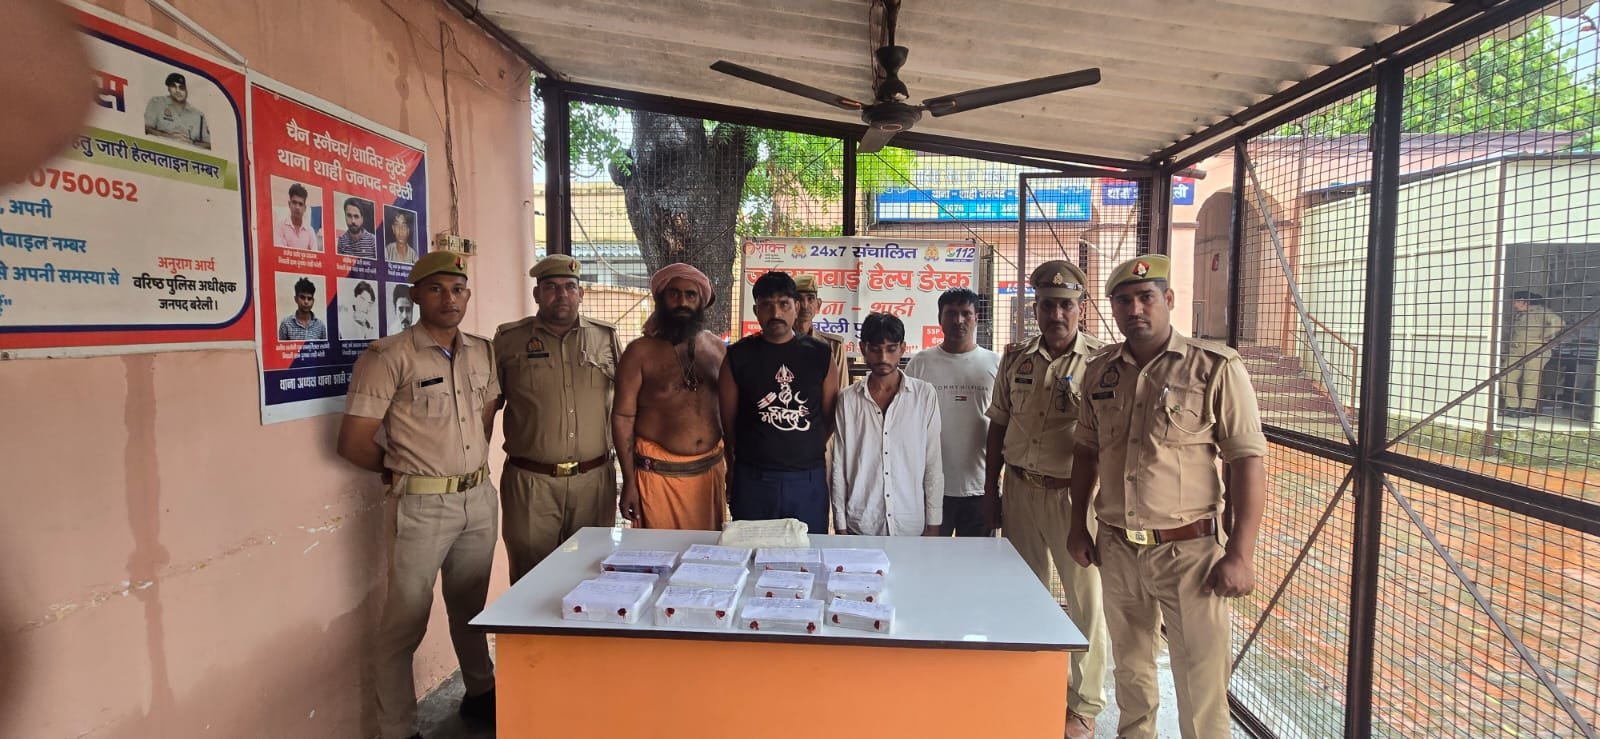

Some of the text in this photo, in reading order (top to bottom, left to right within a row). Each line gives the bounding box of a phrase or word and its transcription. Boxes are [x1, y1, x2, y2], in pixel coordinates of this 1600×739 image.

[96, 138, 128, 159] जारी
[131, 143, 189, 173] हेल्पलाइन
[191, 160, 220, 180] नम्बर
[286, 118, 310, 145] चैन
[385, 157, 408, 181] लुटेरे
[277, 148, 311, 173] थाना
[313, 158, 343, 181] शाही
[344, 168, 382, 192] जनपद
[388, 181, 413, 201] बरेली
[9, 199, 52, 218] अपनी
[51, 237, 87, 254] नम्बर
[810, 243, 918, 259] 24x7 संचालित
[955, 247, 976, 258] 112
[13, 263, 55, 282] अपनी
[58, 269, 105, 285] समस्या
[107, 267, 120, 285] से
[158, 256, 216, 274] अनुराग आर्य
[132, 272, 237, 295] वरिष्ठ पुलिस अधीक्षक
[868, 263, 914, 290] हेल्प
[919, 264, 972, 292] डेस्क
[158, 299, 188, 311] जनपद
[279, 377, 296, 391] थाना
